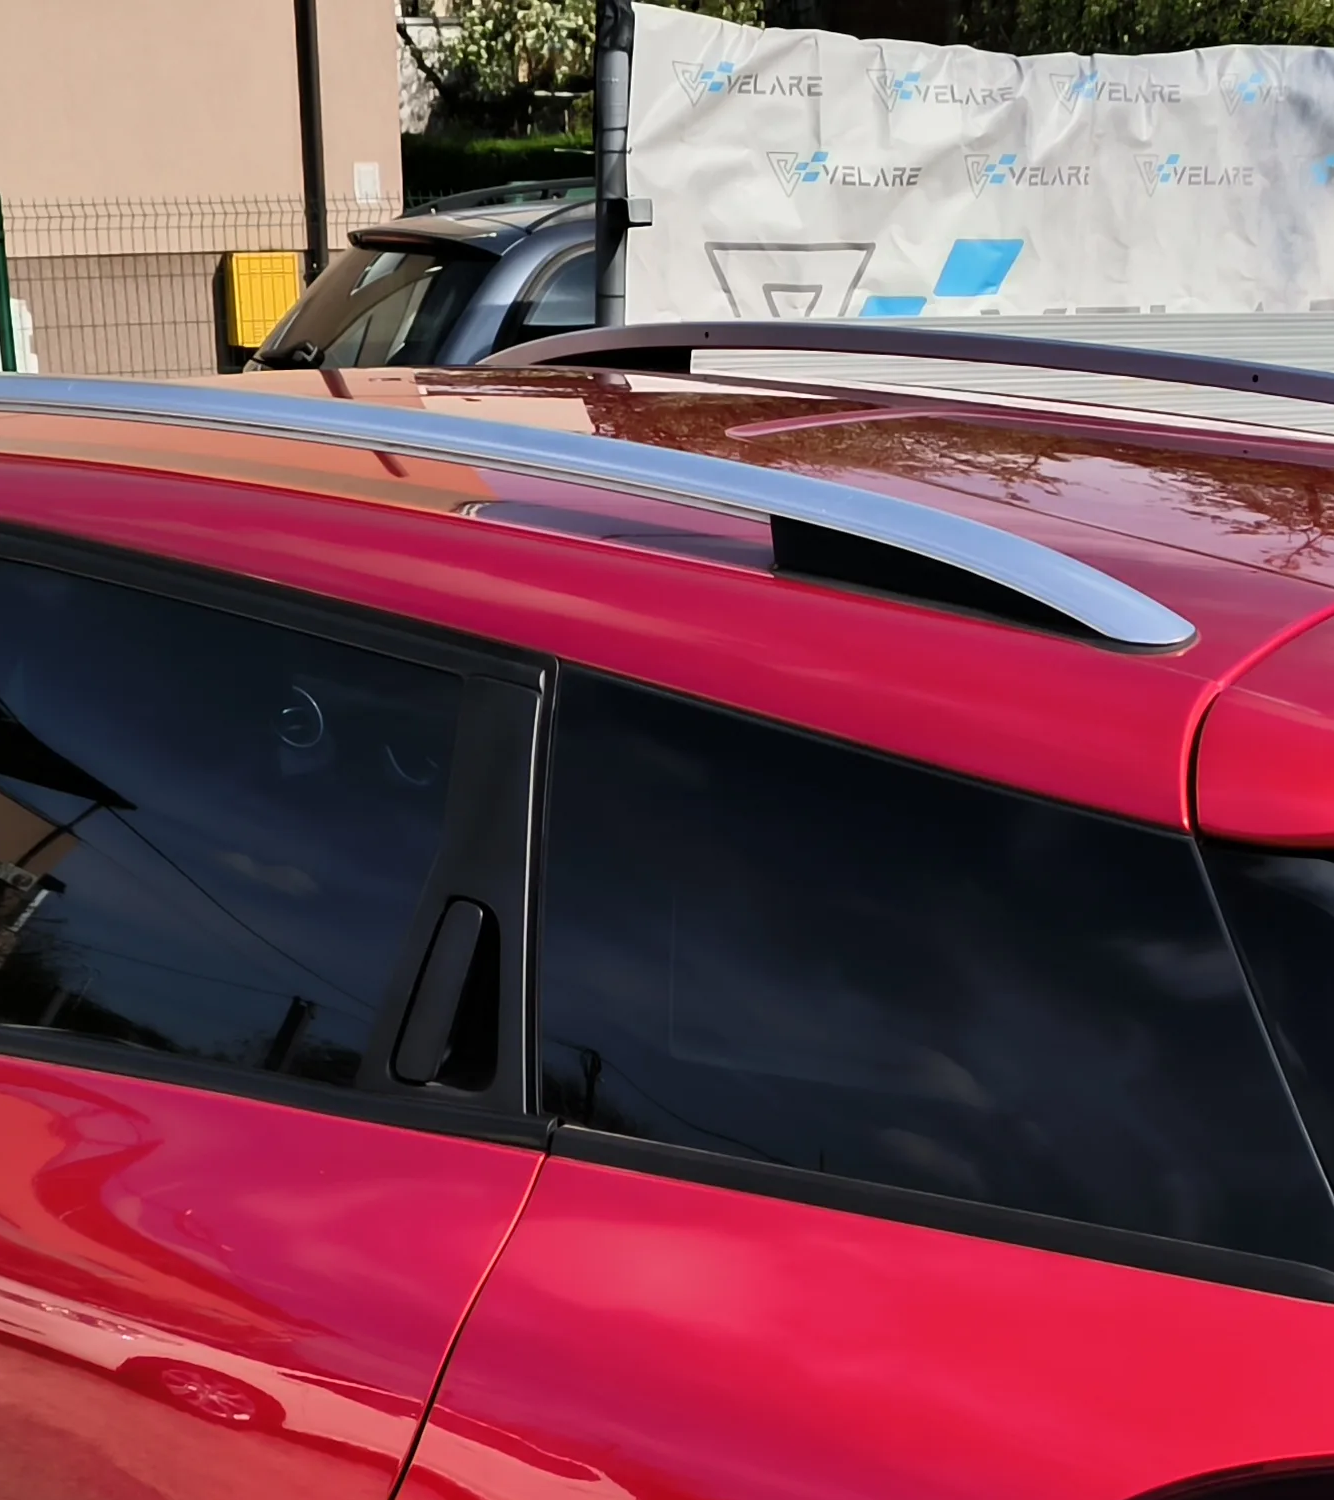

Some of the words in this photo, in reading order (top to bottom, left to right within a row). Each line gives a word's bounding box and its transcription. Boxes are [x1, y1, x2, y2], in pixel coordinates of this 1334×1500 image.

[725, 73, 823, 97] VELARE
[914, 84, 1016, 105] VELARE
[1095, 81, 1181, 104] VELARE
[822, 163, 923, 188] VELARE
[1174, 164, 1254, 187] VELARE
